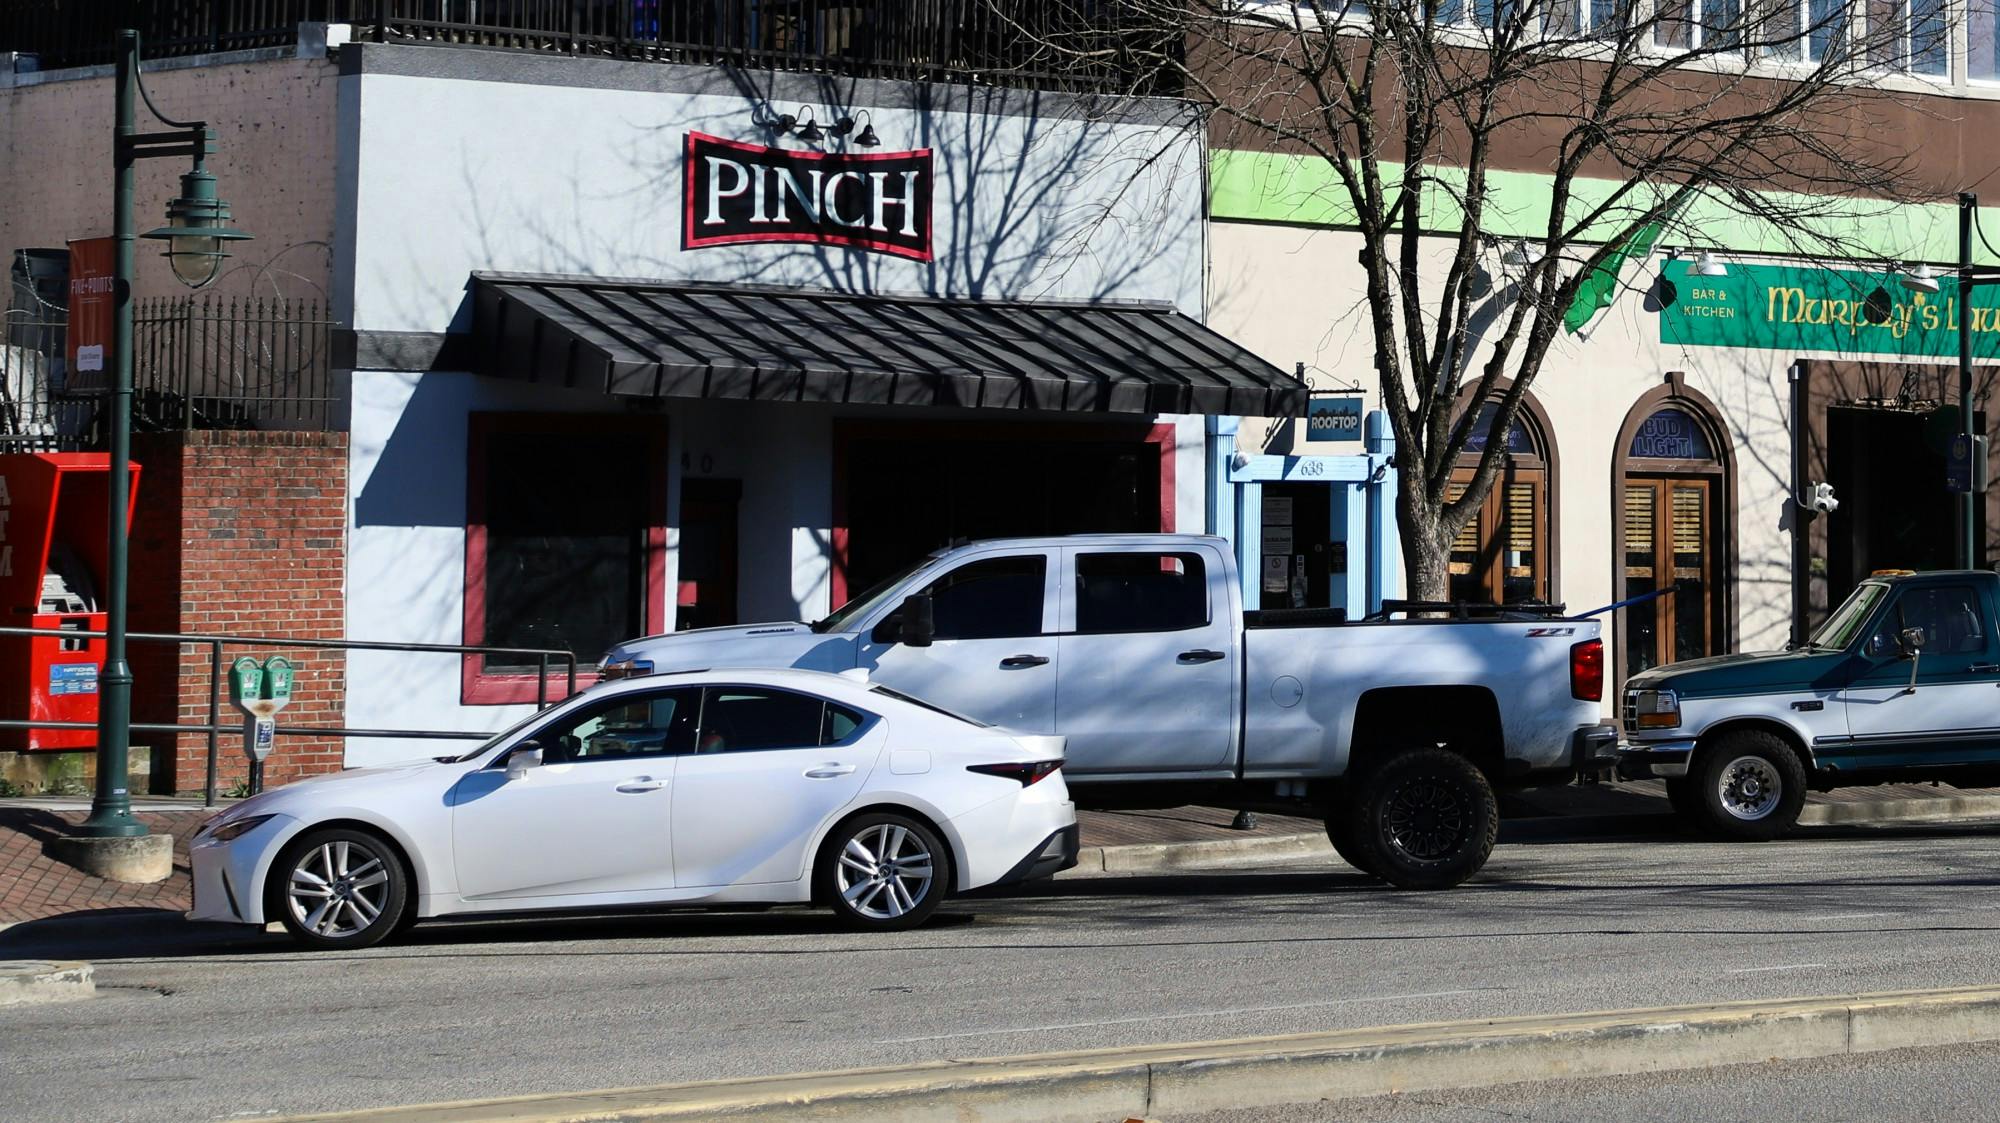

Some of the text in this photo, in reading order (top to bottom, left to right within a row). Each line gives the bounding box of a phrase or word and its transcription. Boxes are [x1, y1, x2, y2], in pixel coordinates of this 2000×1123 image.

[703, 155, 919, 237] PINCH
[1692, 288, 1726, 300] BAR &
[1684, 305, 1734, 318] KITCHEN
[1768, 287, 1939, 339] Murpy's
[1312, 416, 1357, 429] ROOFTOP
[1644, 418, 1680, 437] BUD
[1635, 437, 1689, 456] LIGHT
[1301, 461, 1323, 476] 638
[1524, 628, 1576, 637] Z71
